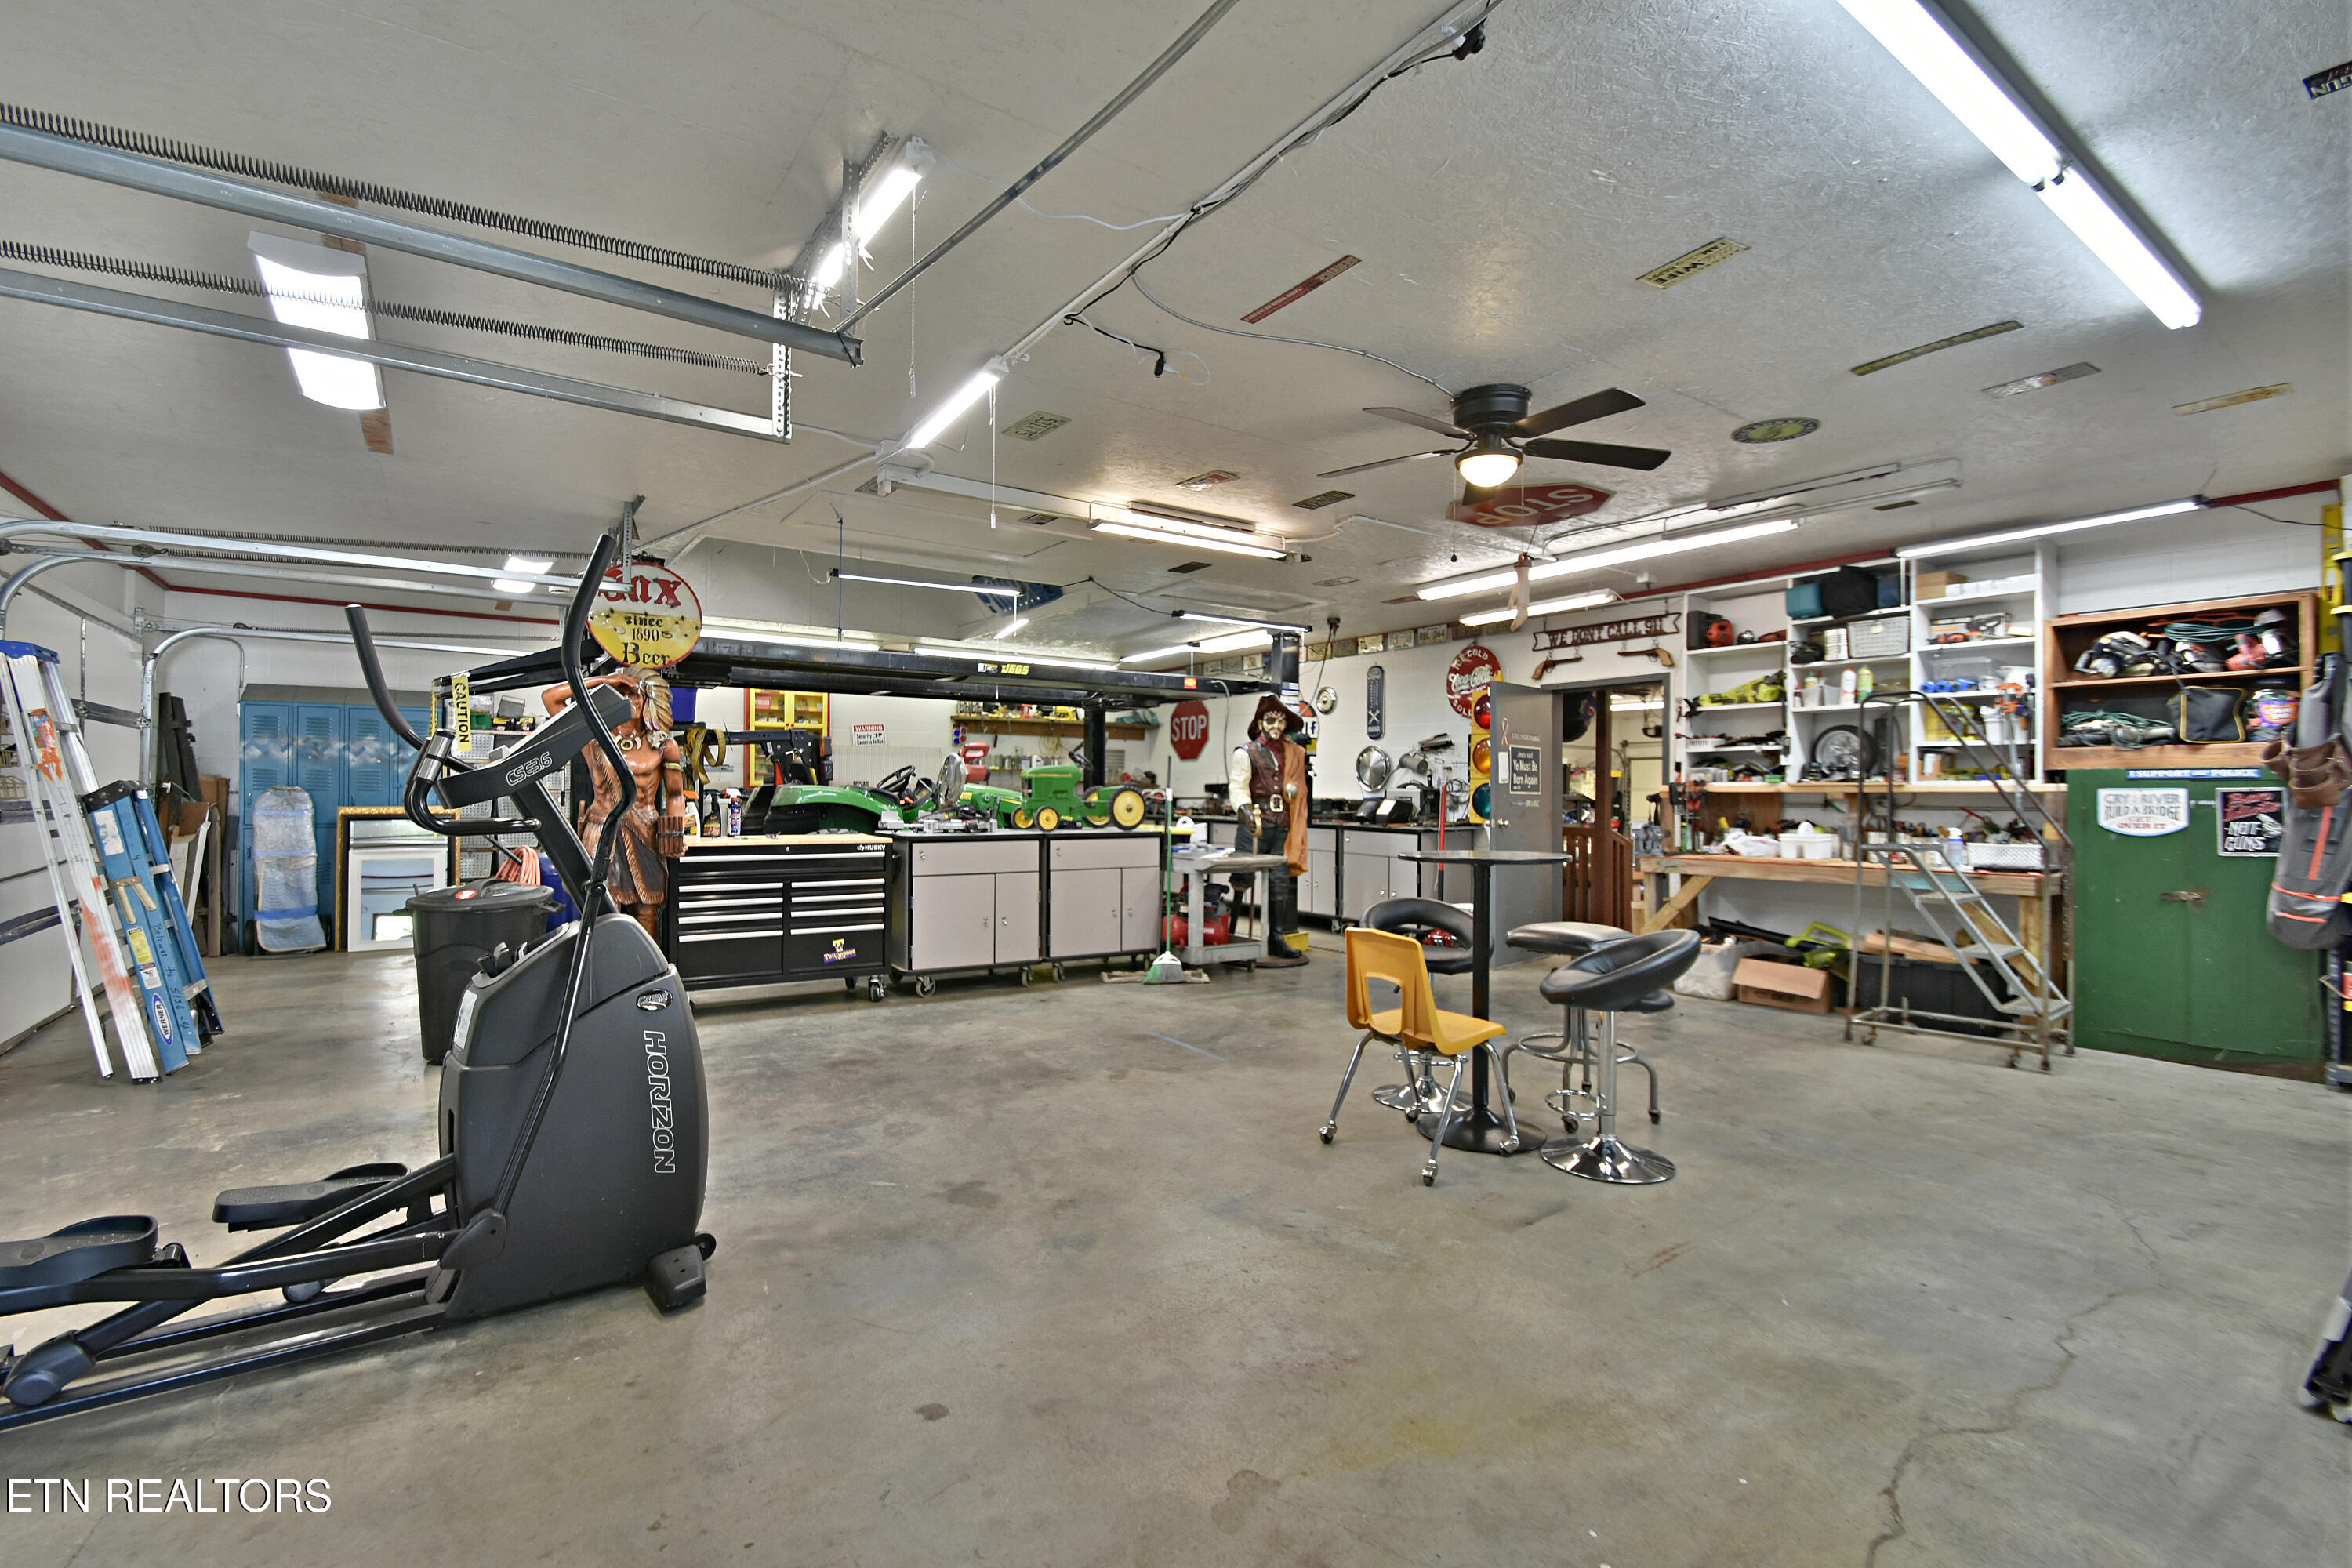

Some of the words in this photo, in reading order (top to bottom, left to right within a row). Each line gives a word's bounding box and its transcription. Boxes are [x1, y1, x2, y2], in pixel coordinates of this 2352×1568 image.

[1652, 263, 1704, 284] WIFE
[1477, 488, 1594, 524] STOP
[625, 615, 663, 628] since
[1549, 633, 1566, 647] WE
[1607, 622, 1639, 637] CALL
[1645, 617, 1664, 632] 911
[632, 628, 659, 641] 1890
[622, 641, 670, 665] Beer
[1451, 654, 1467, 670] ICE
[1467, 648, 1488, 660] COLD
[1001, 663, 1030, 675] JEGS
[454, 682, 470, 743] CAUTION
[1171, 714, 1207, 742] STOP
[506, 751, 553, 786] CSE3.6
[1512, 759, 1519, 771] Ye
[1519, 760, 1531, 772] Must
[1531, 760, 1538, 772] Be
[1513, 773, 1523, 785] Born
[1524, 774, 1538, 789] Again
[2104, 794, 2129, 804] CRY
[2140, 793, 2180, 804] RIVER
[2105, 805, 2129, 821] BUILD
[2144, 805, 2181, 822] BRIDGE
[2228, 821, 2261, 835] NOT
[2225, 836, 2267, 851] GUNS
[156, 1004, 170, 1036] WERNER
[644, 1030, 676, 1174] HORIZON
